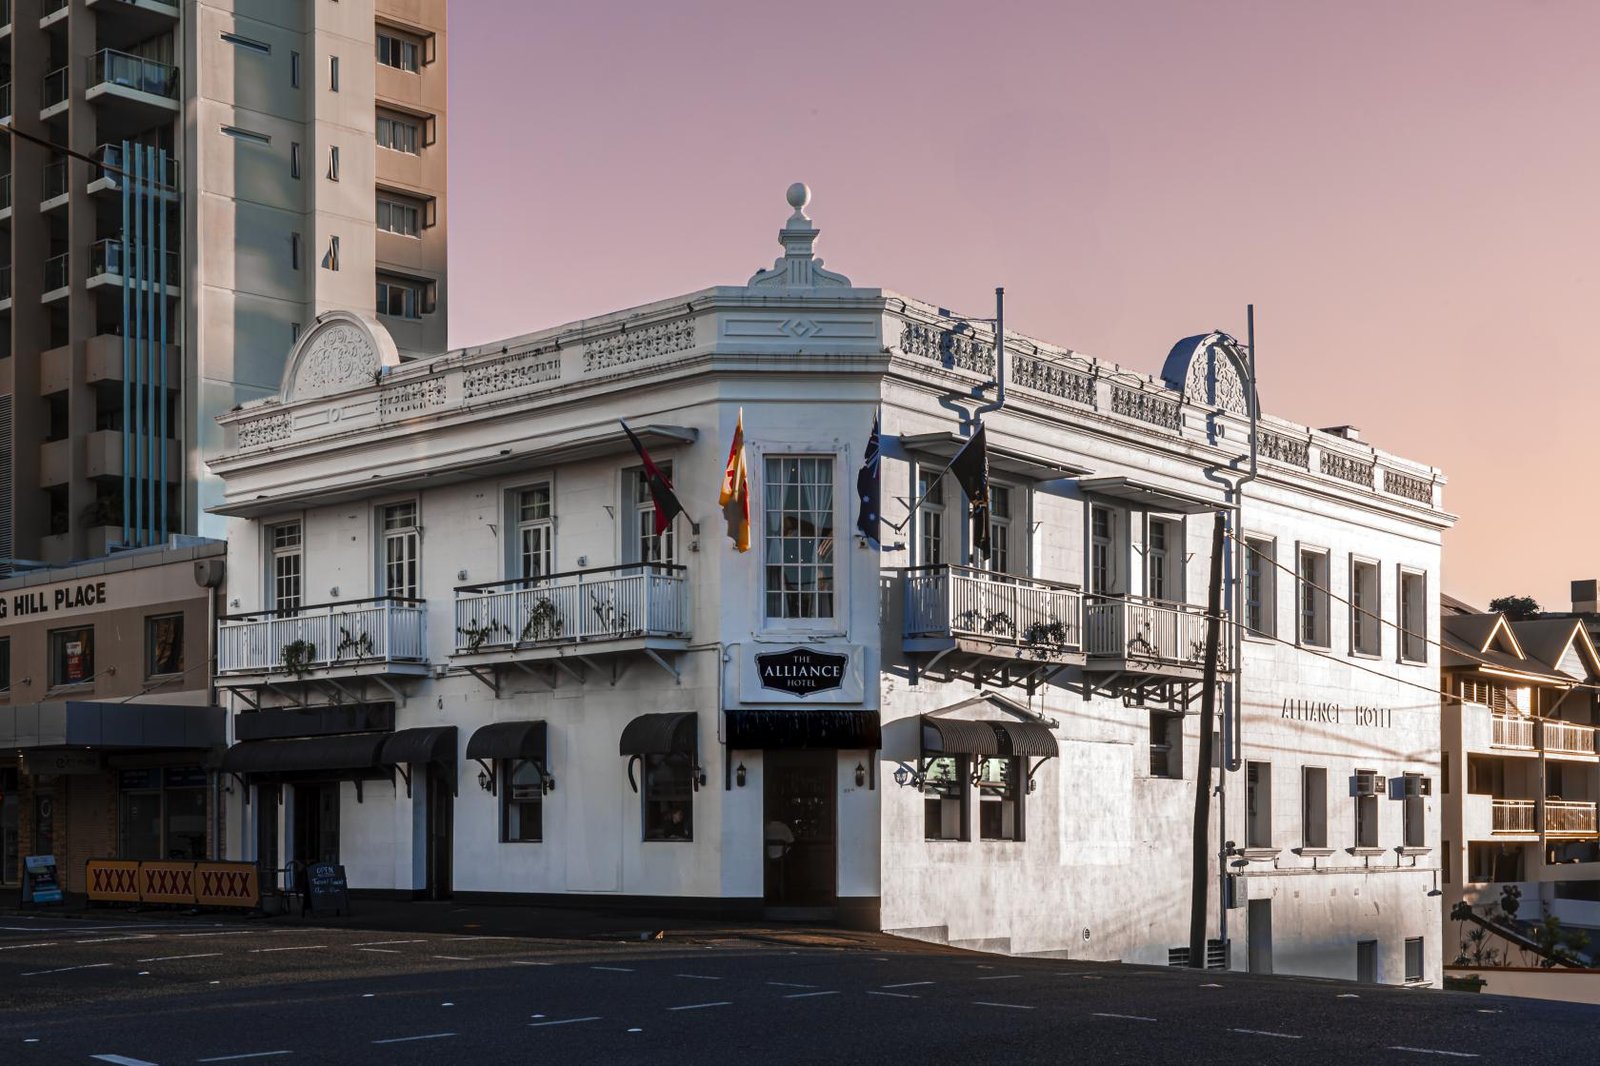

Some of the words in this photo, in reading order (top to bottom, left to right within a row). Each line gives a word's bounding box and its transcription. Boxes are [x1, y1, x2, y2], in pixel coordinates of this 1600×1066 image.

[14, 592, 48, 616] HILL
[54, 582, 106, 610] PLACE
[764, 665, 840, 677] ALLIANCE
[793, 655, 811, 664] THE
[787, 679, 816, 687] HOTEL
[93, 868, 137, 893] XXXX
[145, 869, 192, 895] XXXX
[202, 871, 251, 897] XXXX
